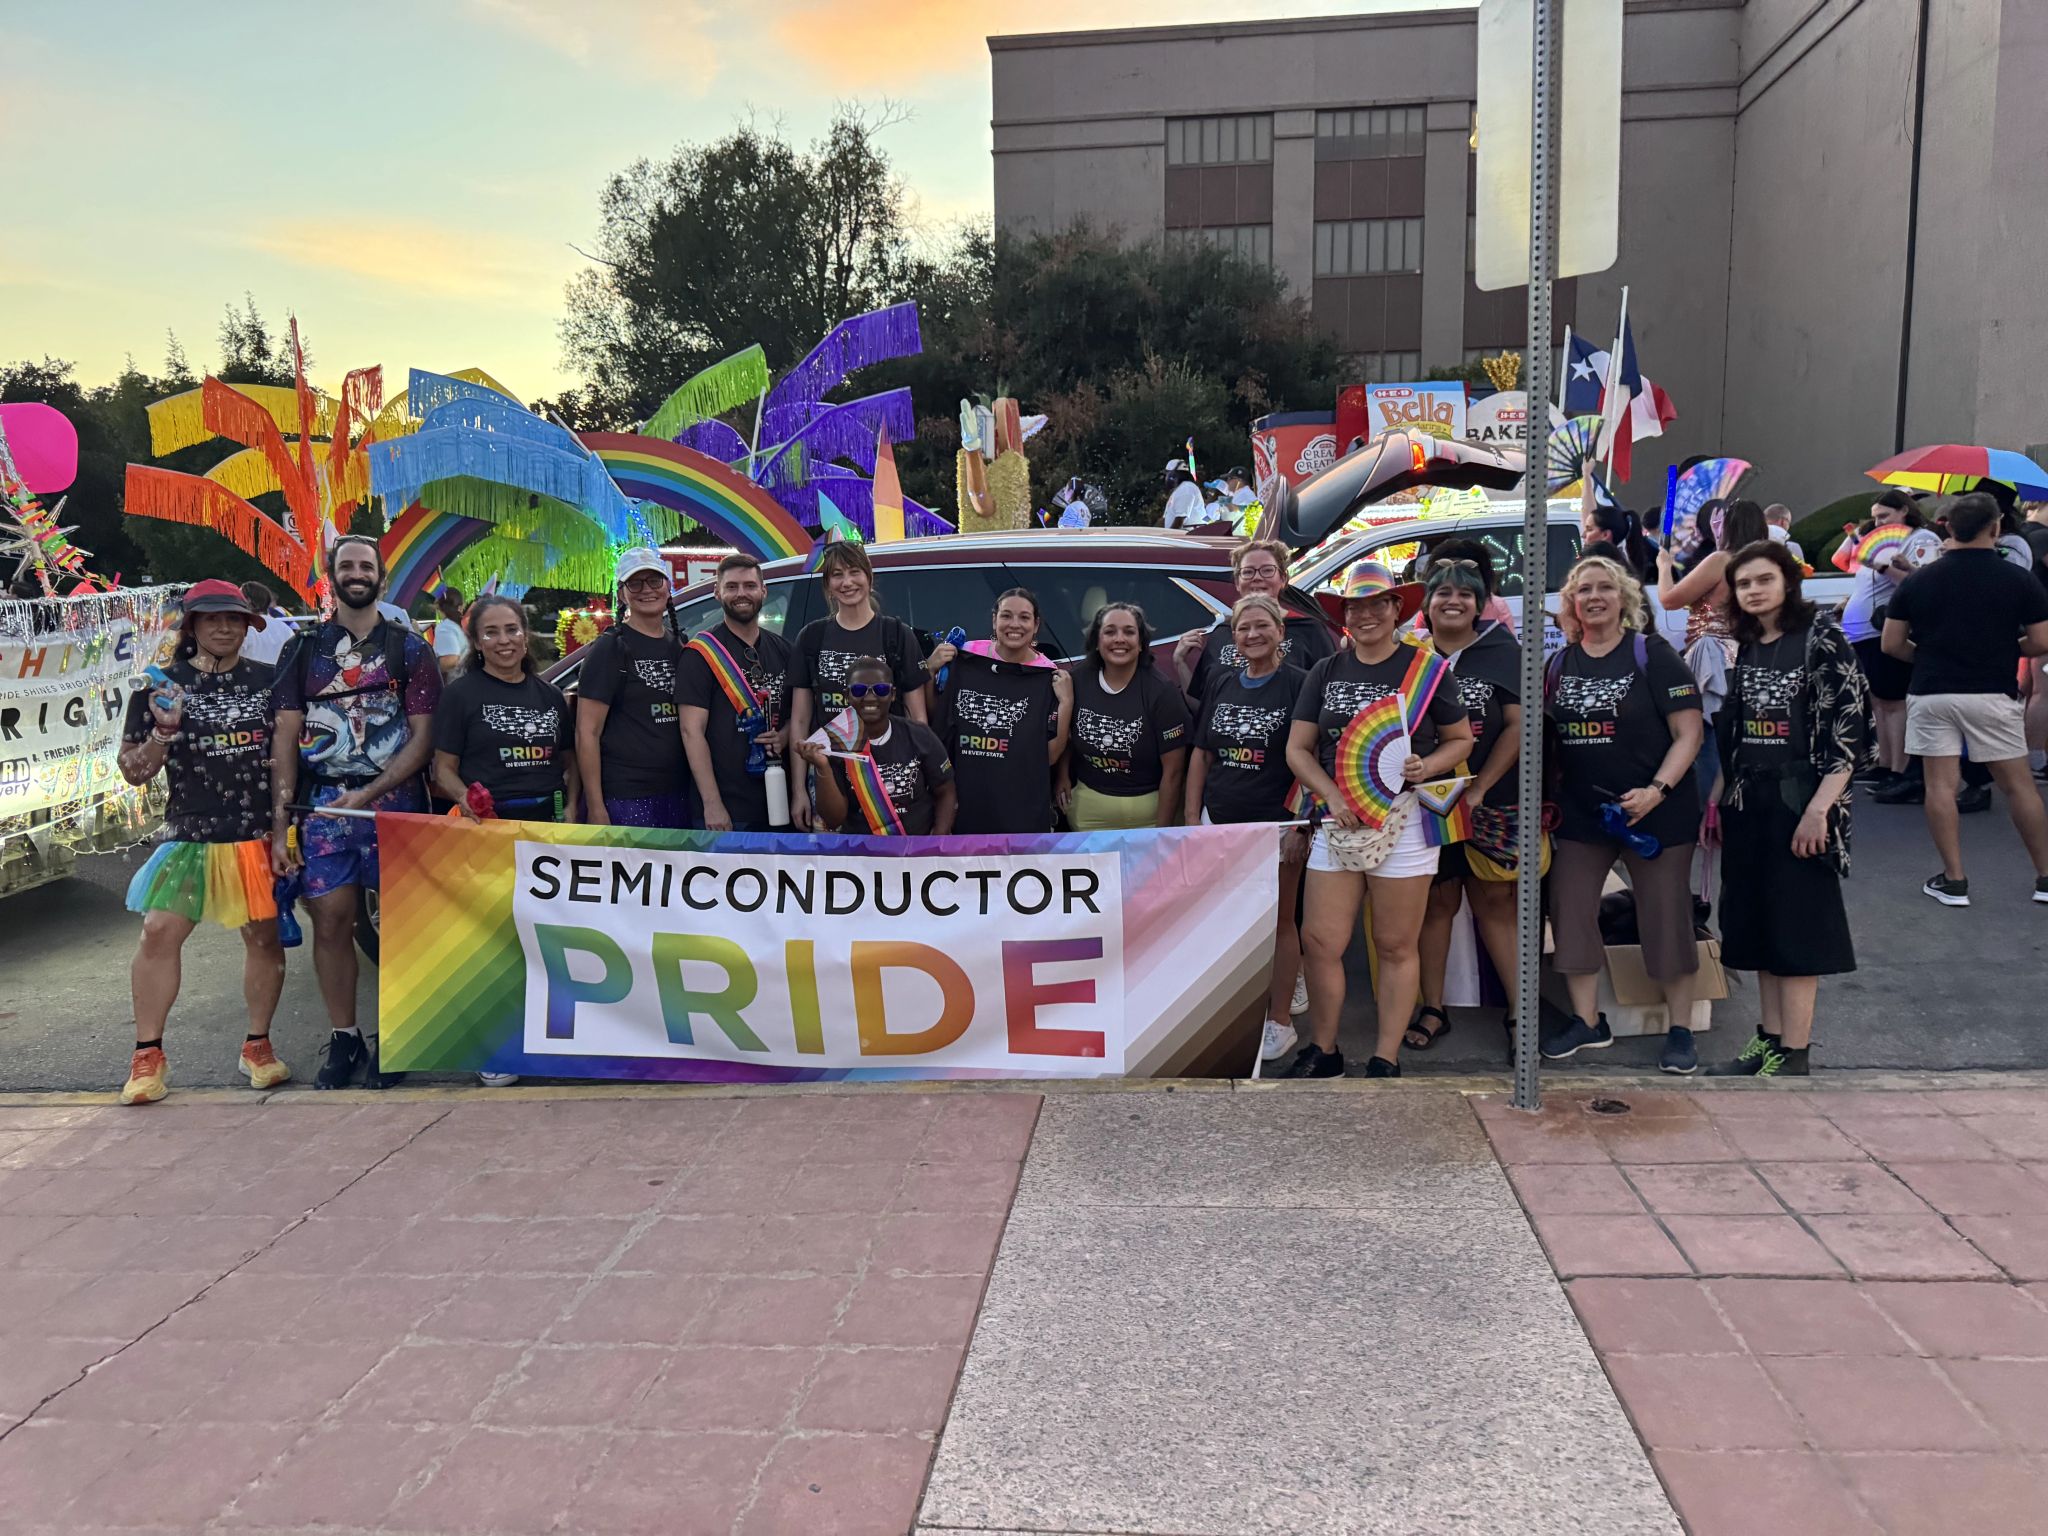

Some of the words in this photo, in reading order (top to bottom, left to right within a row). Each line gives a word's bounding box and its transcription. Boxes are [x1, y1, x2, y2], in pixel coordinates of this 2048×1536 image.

[1379, 393, 1454, 426] Bella
[24, 685, 58, 697] SHINES
[1557, 721, 1616, 736] PRIDE
[199, 729, 264, 751] PRIDE
[960, 735, 1009, 751] PRIDE
[44, 744, 80, 760] FRIENDS
[499, 746, 553, 760] PRIDE
[1218, 748, 1265, 763] PRIDE
[529, 855, 1101, 916] SEMICONDUCTOR
[533, 922, 1106, 1058] PRIDE
